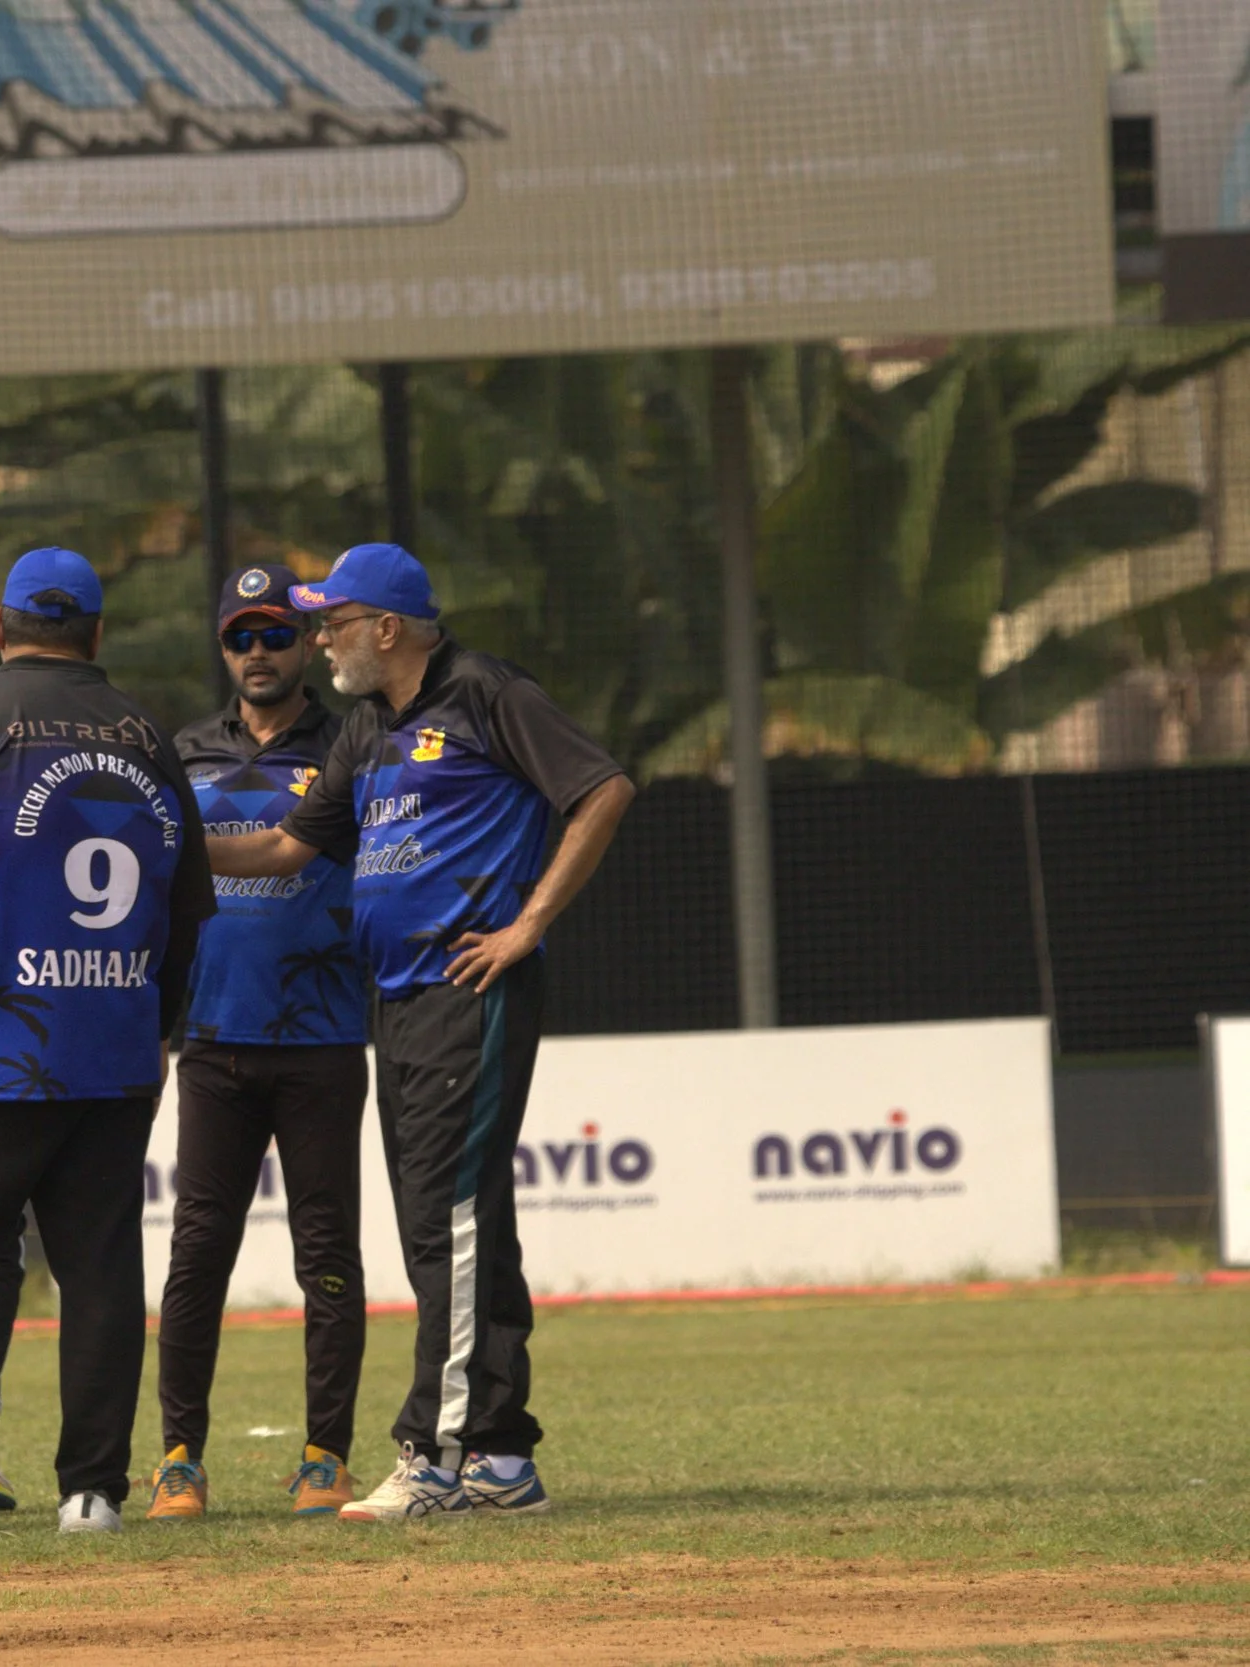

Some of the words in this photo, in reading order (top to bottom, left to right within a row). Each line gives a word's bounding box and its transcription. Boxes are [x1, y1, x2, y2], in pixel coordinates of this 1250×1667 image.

[14, 782, 51, 837] CUTCHI
[41, 752, 94, 789] MEMON
[96, 752, 157, 800] PREMIER
[64, 836, 141, 930] 9
[513, 1123, 654, 1187] avio
[753, 1108, 962, 1178] navio
